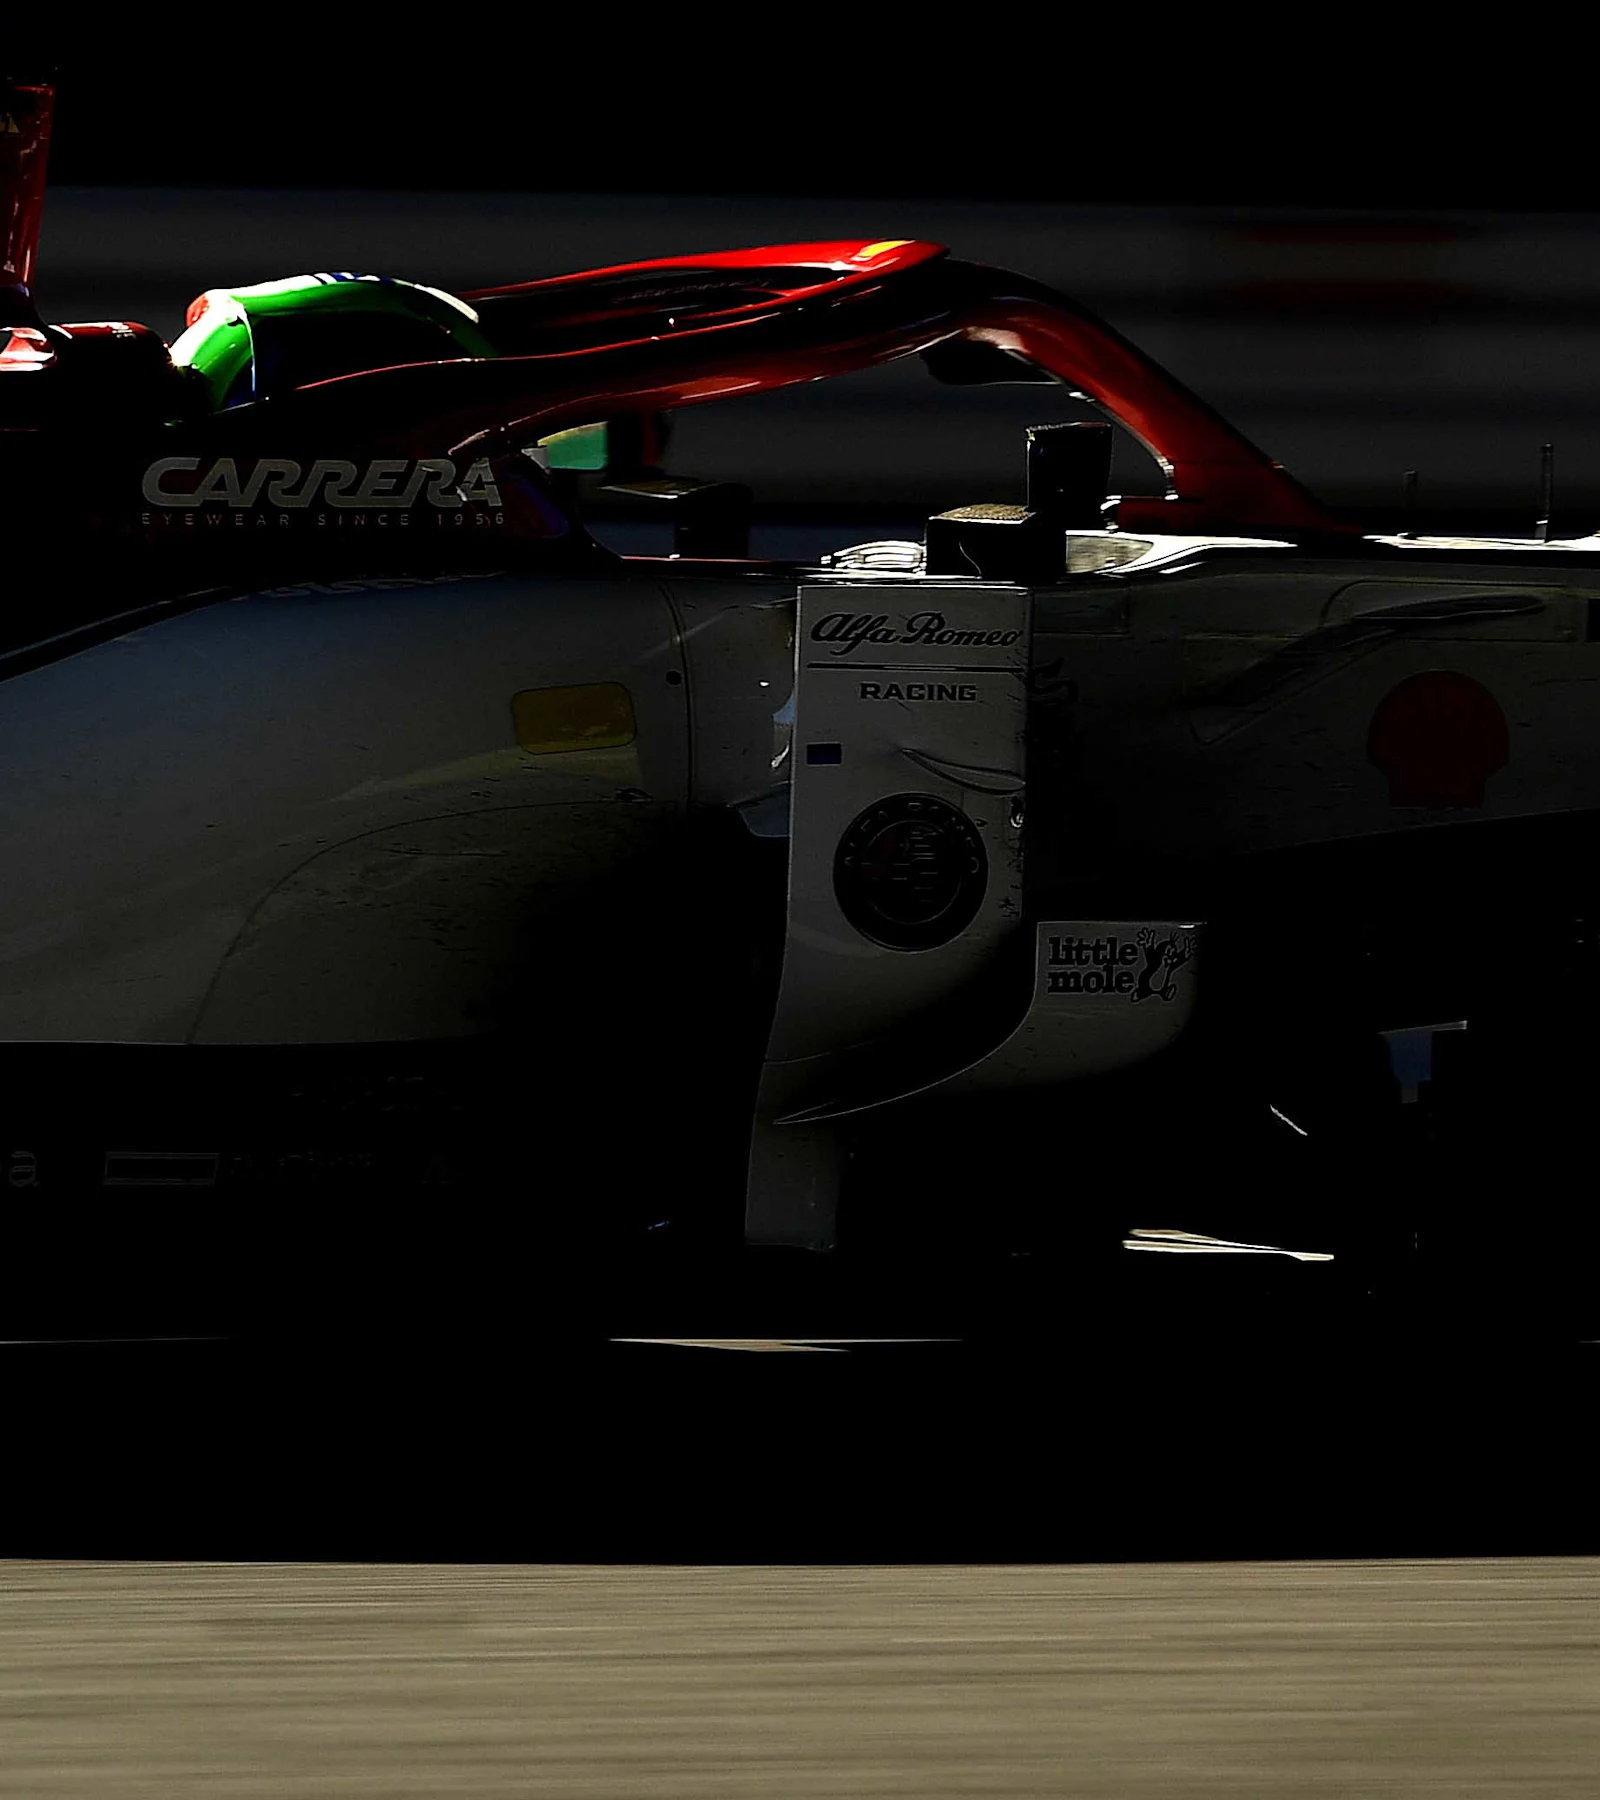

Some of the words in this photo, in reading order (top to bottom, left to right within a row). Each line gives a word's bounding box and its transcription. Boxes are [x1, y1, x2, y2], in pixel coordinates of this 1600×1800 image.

[142, 457, 502, 508] CARRERA
[141, 512, 292, 527] EYEWEAR
[317, 513, 410, 527] SINCE
[437, 512, 504, 526] 1956
[811, 613, 901, 656] Alfa
[901, 612, 1022, 646] Romeo
[861, 683, 977, 701] RACING
[1048, 937, 1138, 966] little
[1048, 964, 1135, 993] mole
